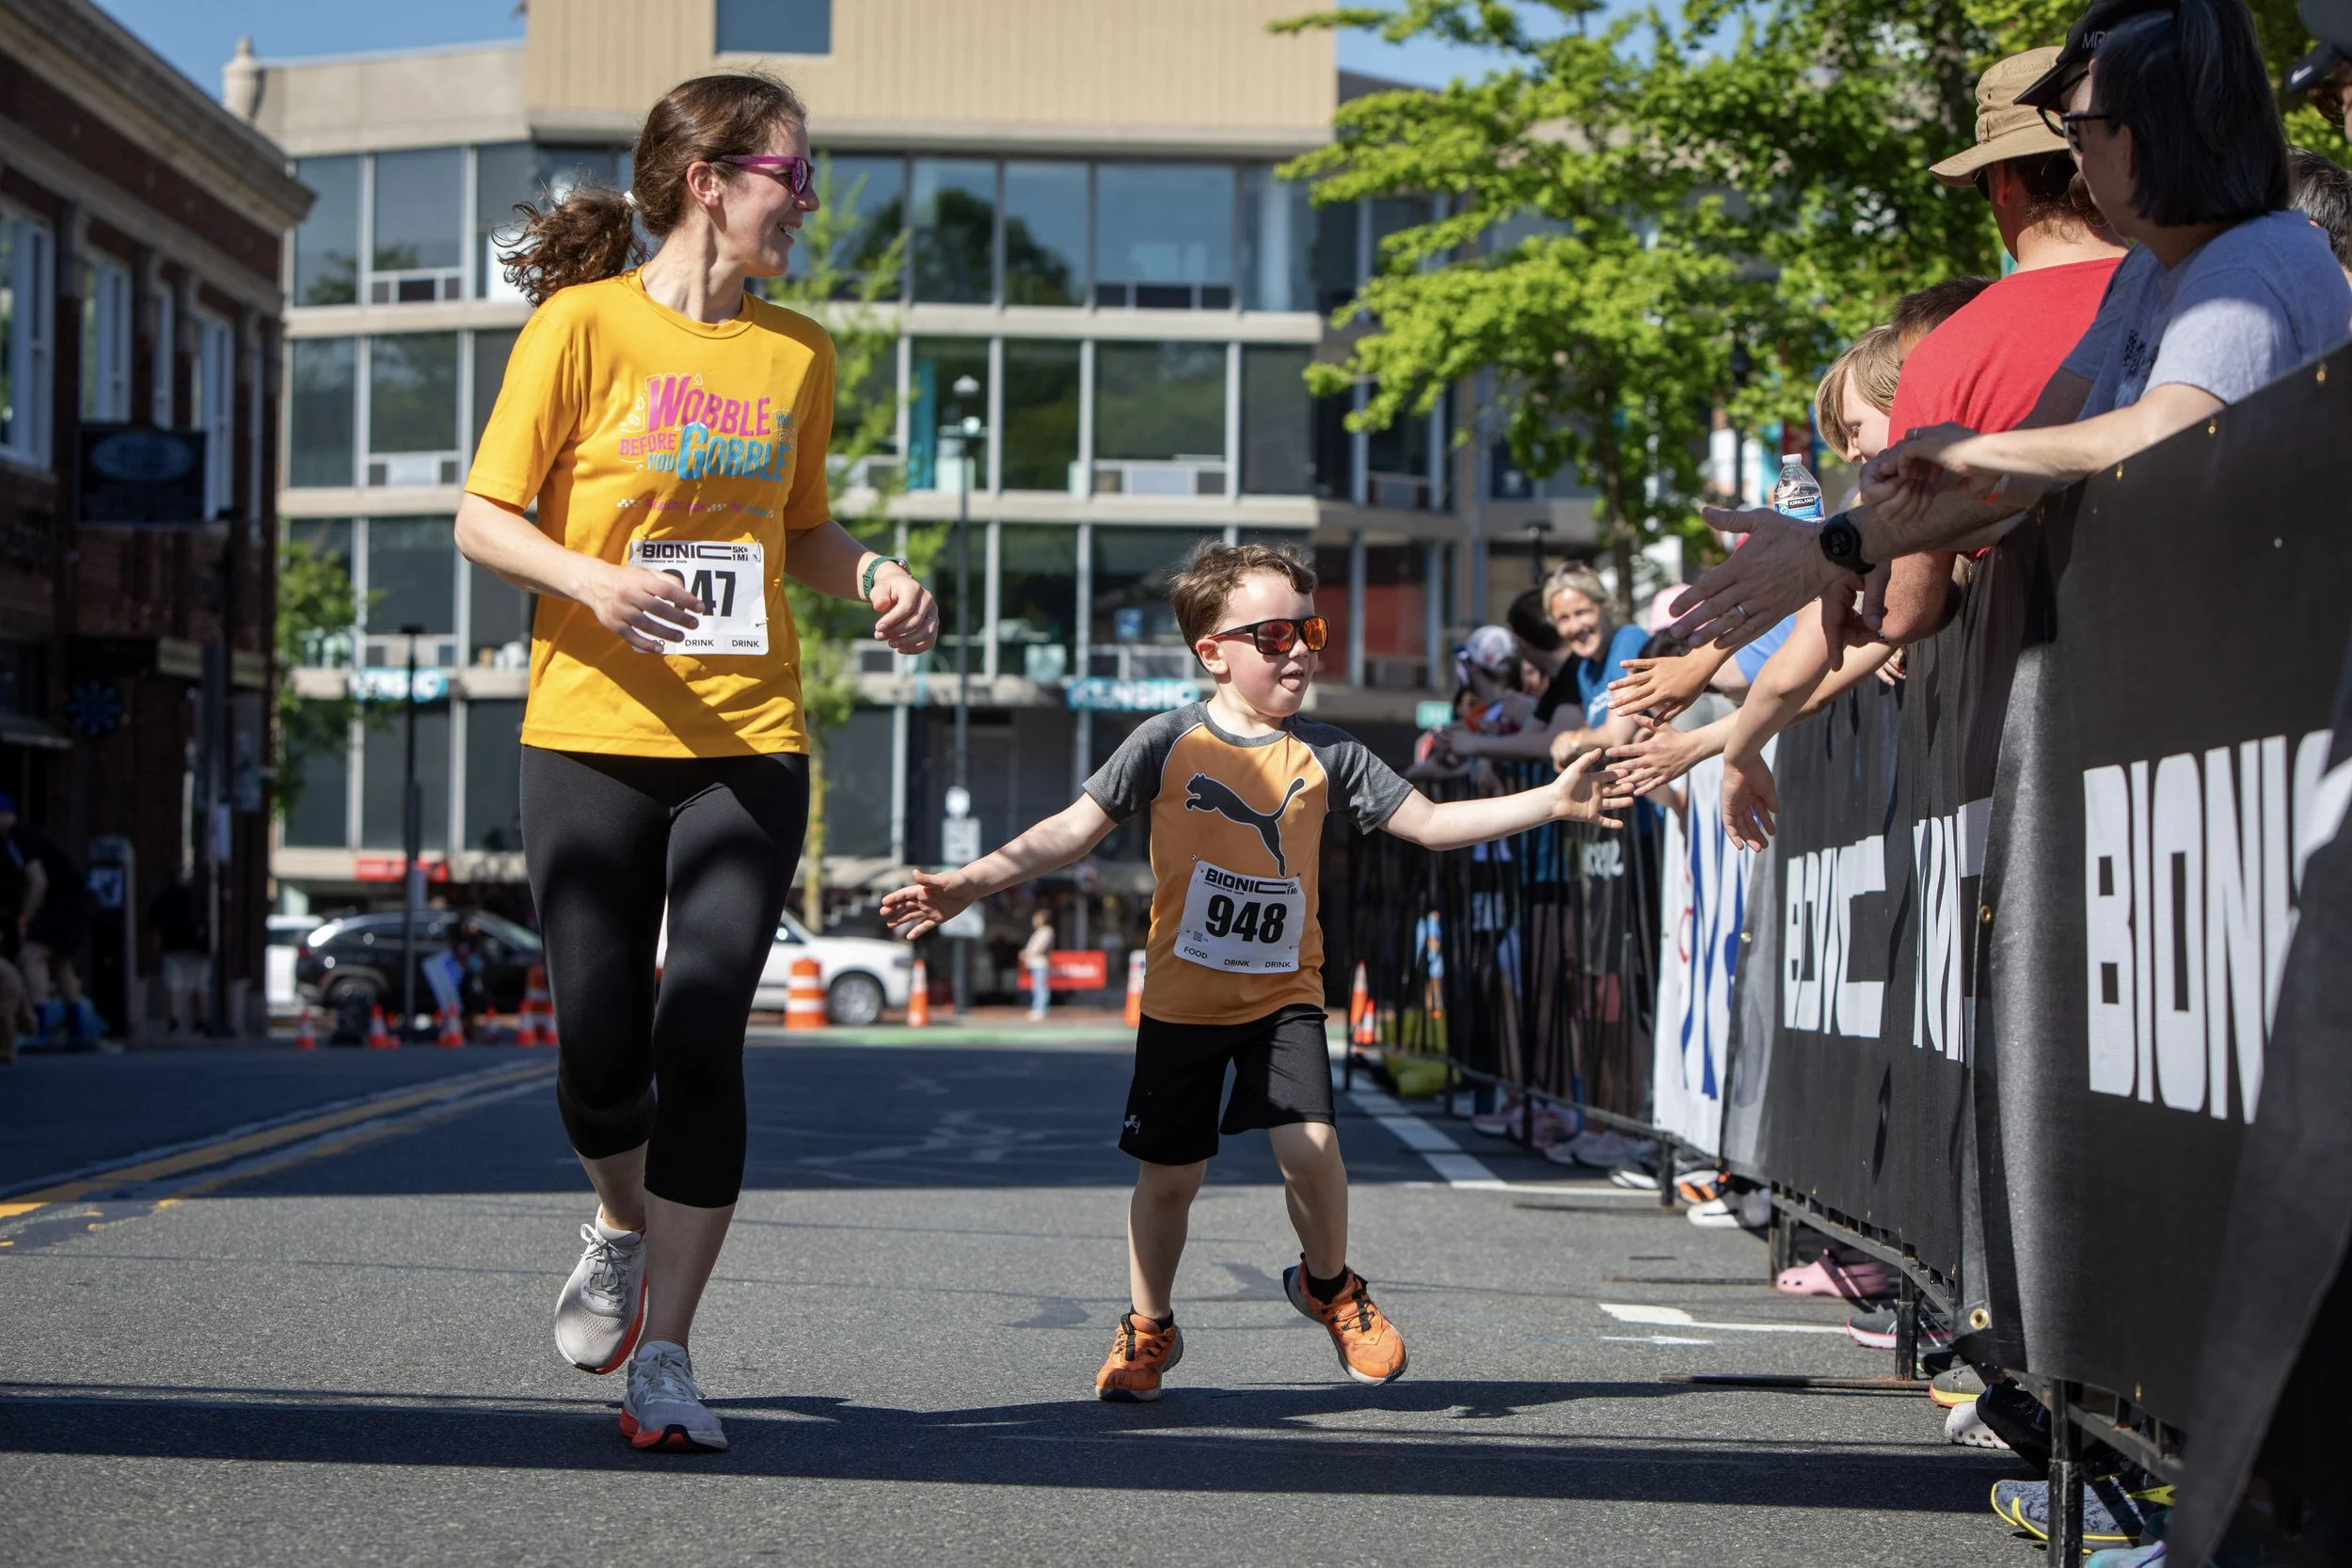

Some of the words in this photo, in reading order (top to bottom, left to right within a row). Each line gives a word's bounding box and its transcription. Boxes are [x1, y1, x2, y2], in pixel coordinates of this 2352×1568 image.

[648, 376, 770, 436] WOBBLE
[619, 433, 676, 456] BEFORE
[647, 453, 675, 473] YOU
[676, 421, 790, 483] GOBBLE
[642, 544, 732, 561] BIONIC
[685, 639, 715, 647] DRINK
[732, 640, 760, 648] DRINK
[1205, 868, 1287, 895] BIONIC
[1205, 895, 1287, 943] 948
[1184, 946, 1208, 959] FOOD
[1224, 958, 1250, 967] DRINK
[1264, 960, 1292, 969] DRINK
